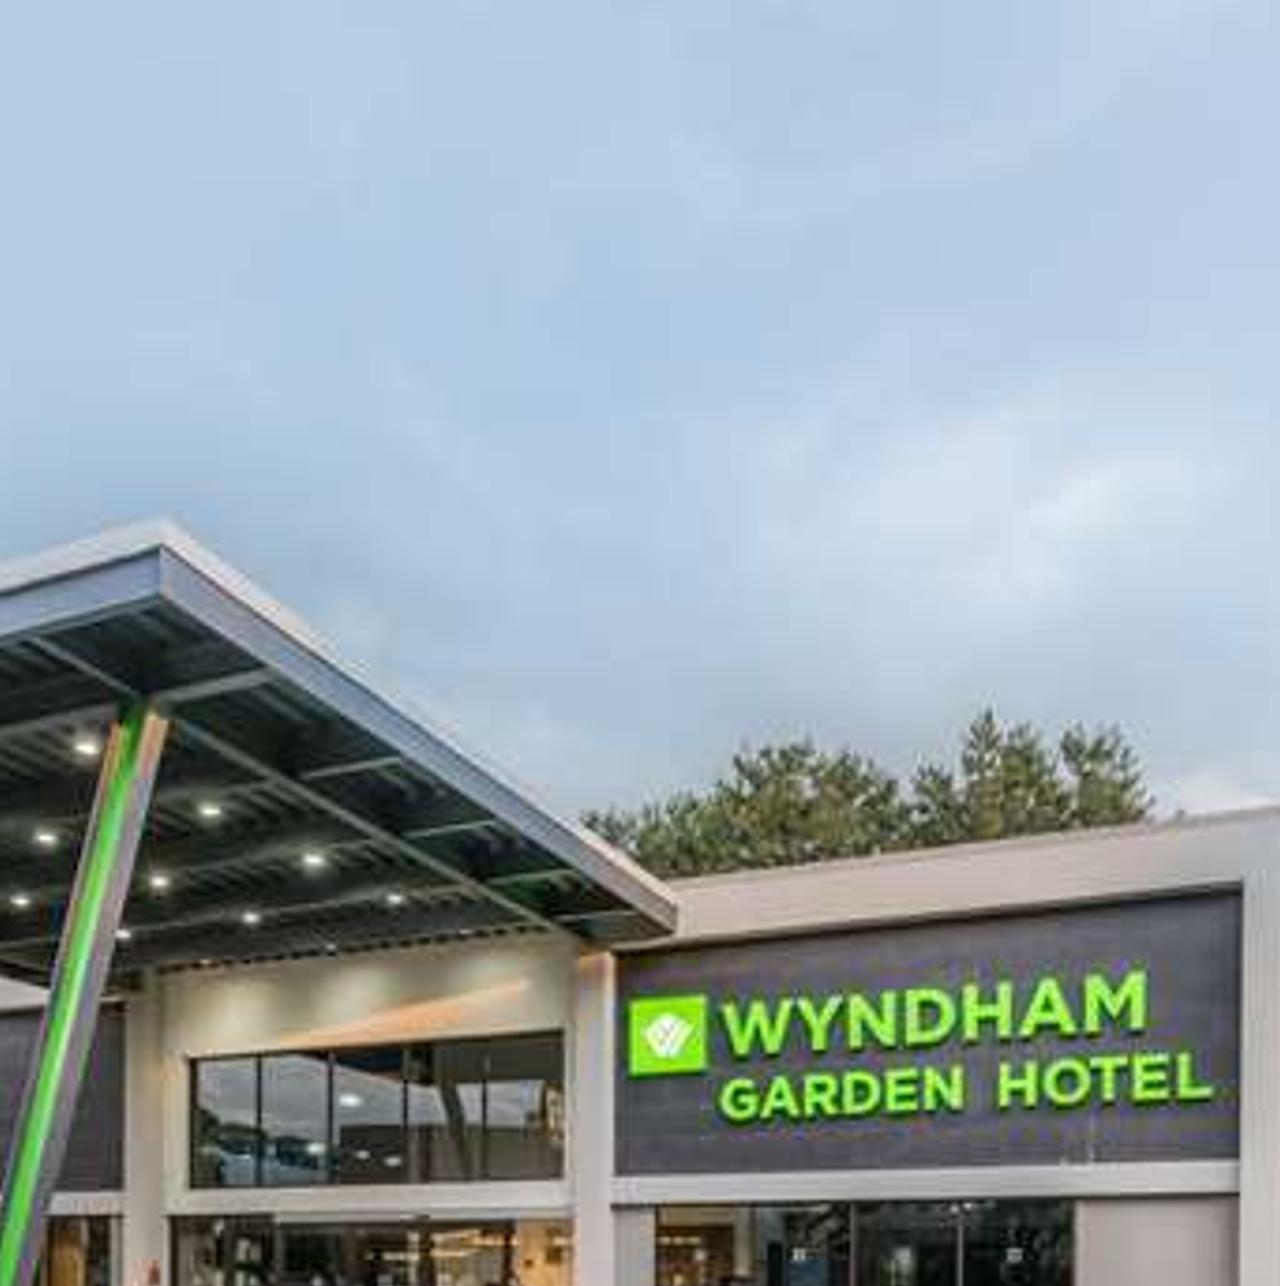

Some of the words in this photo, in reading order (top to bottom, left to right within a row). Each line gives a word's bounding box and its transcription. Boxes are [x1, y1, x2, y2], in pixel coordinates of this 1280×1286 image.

[721, 969, 1148, 1057] WYNDHAM
[719, 1066, 966, 1123] GARDEN
[997, 1051, 1214, 1108] HOTEL
